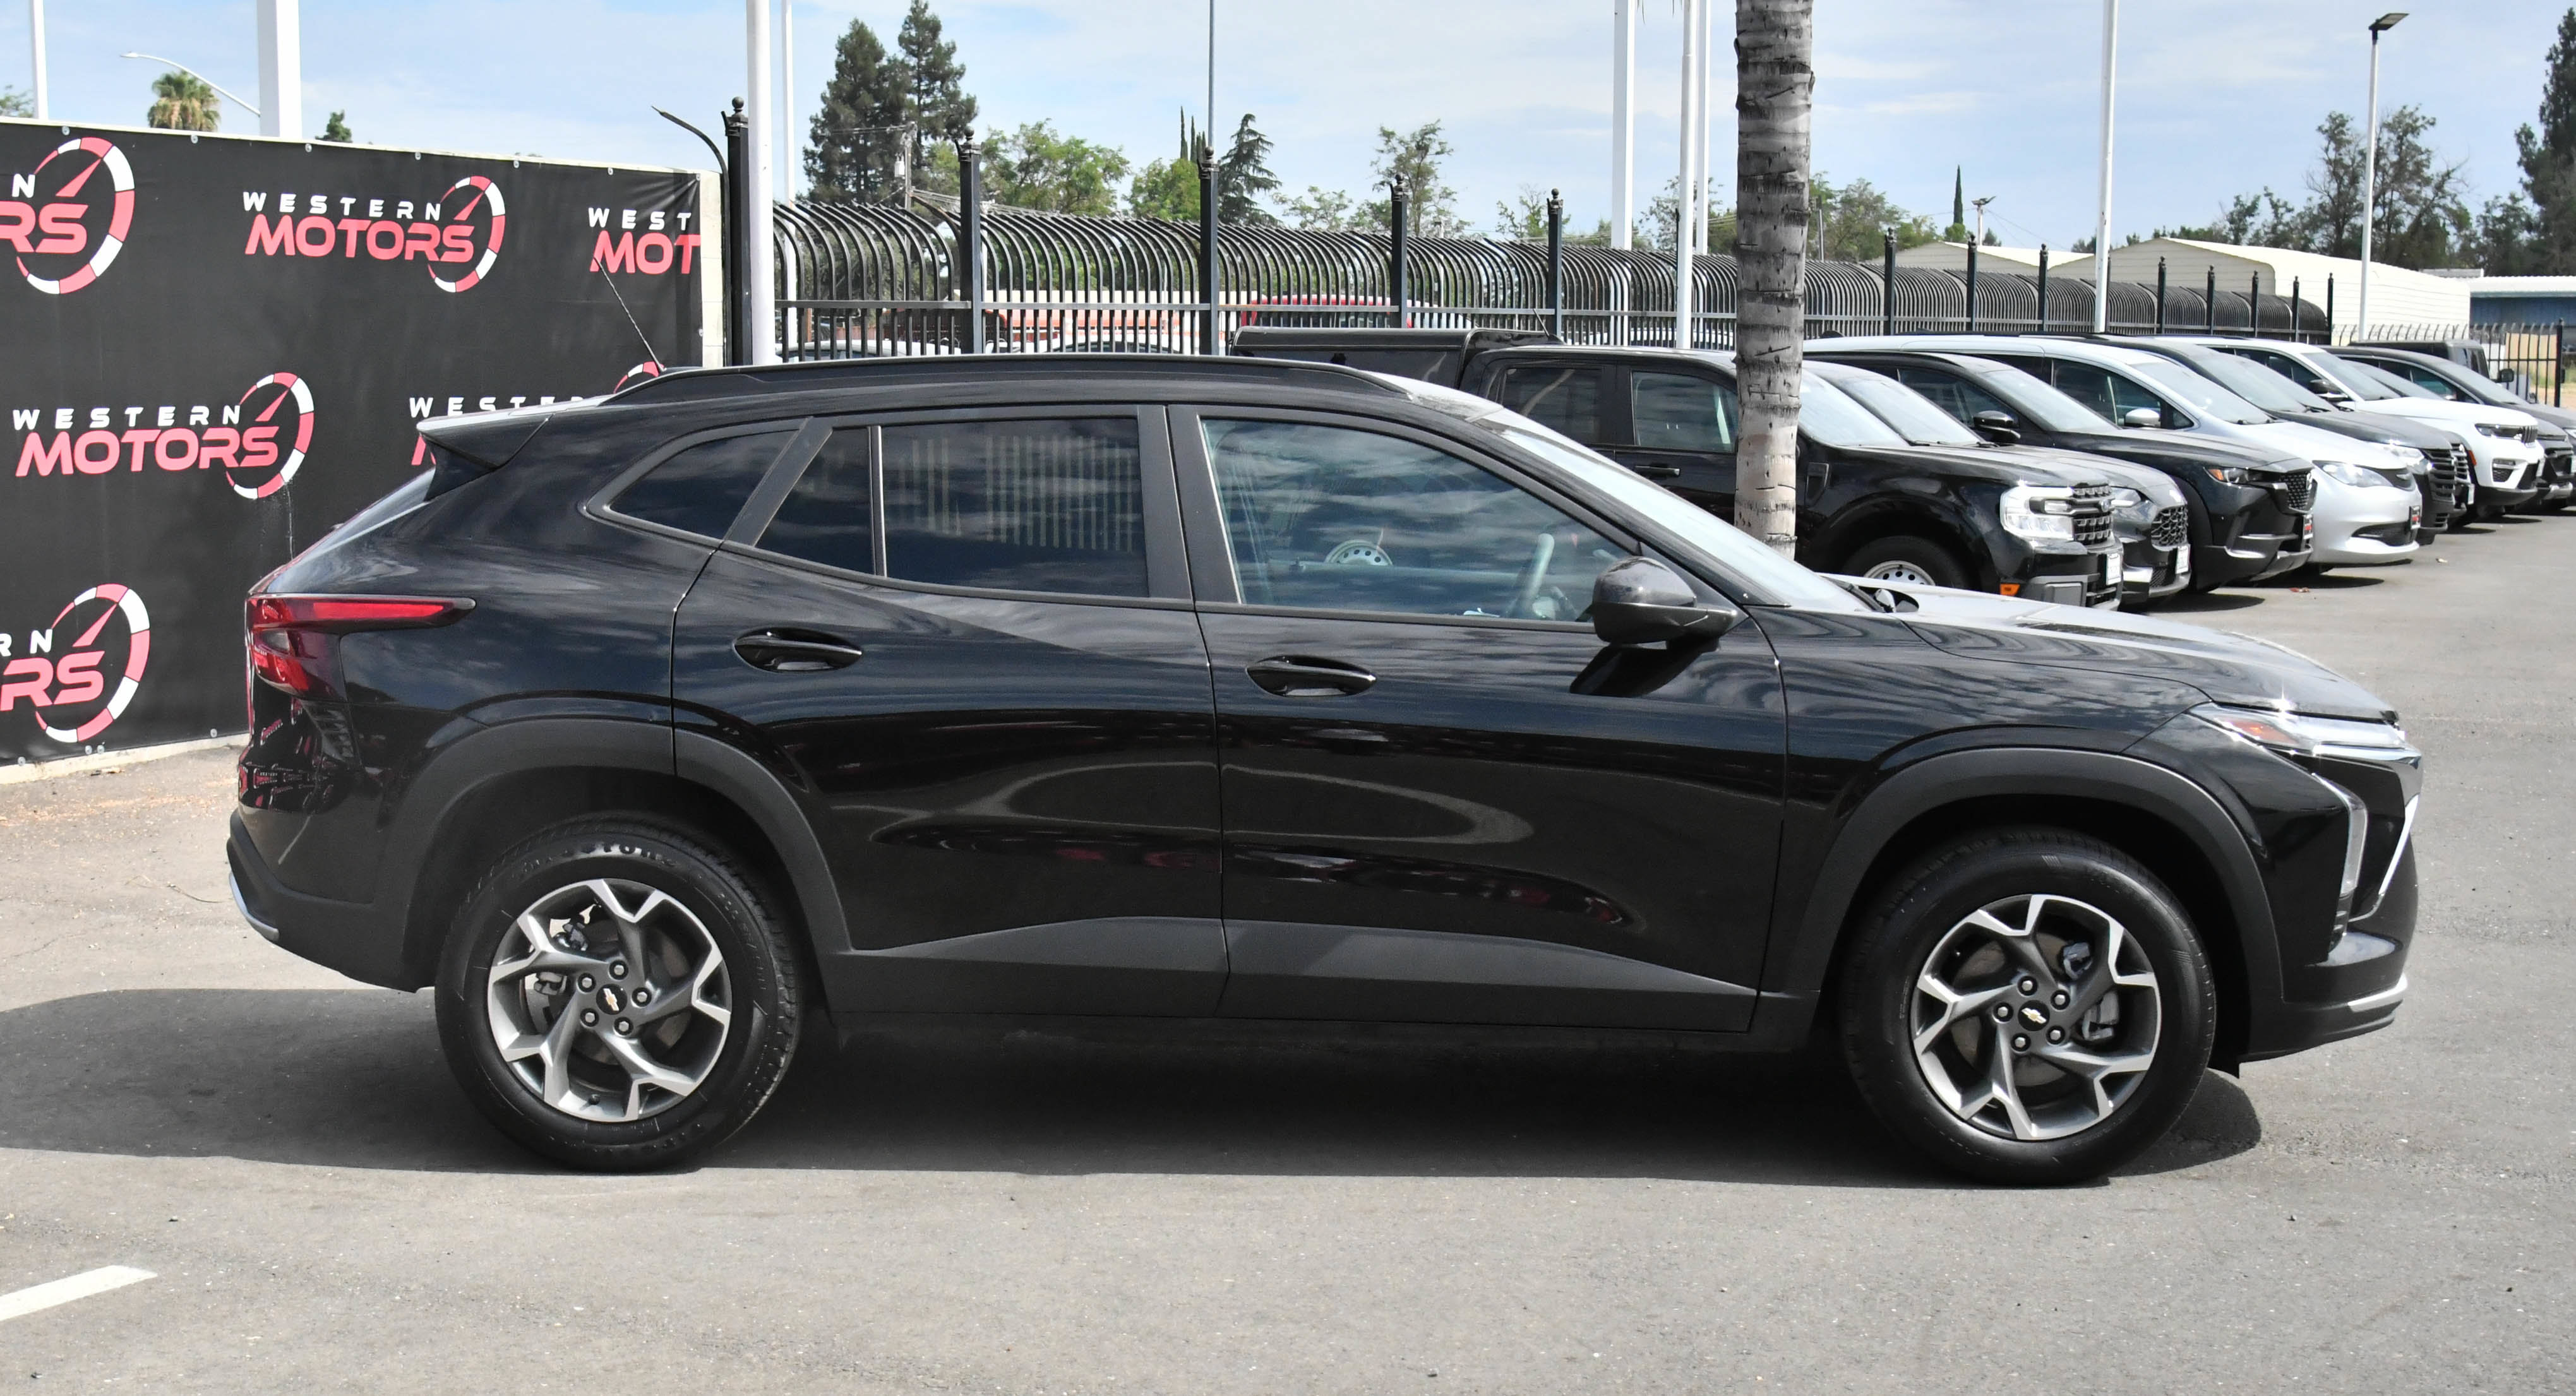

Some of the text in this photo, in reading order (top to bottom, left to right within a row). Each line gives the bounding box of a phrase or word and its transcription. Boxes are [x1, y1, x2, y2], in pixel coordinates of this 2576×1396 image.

[0, 200, 89, 254] RS
[243, 191, 441, 221] WESTERN
[588, 207, 692, 231] WEST
[244, 213, 476, 263] MOTORS
[589, 230, 702, 275] MOT
[12, 405, 241, 431] WESTERN
[409, 396, 584, 418] WEST
[15, 426, 280, 478] MOTORS
[0, 650, 105, 712] RS
